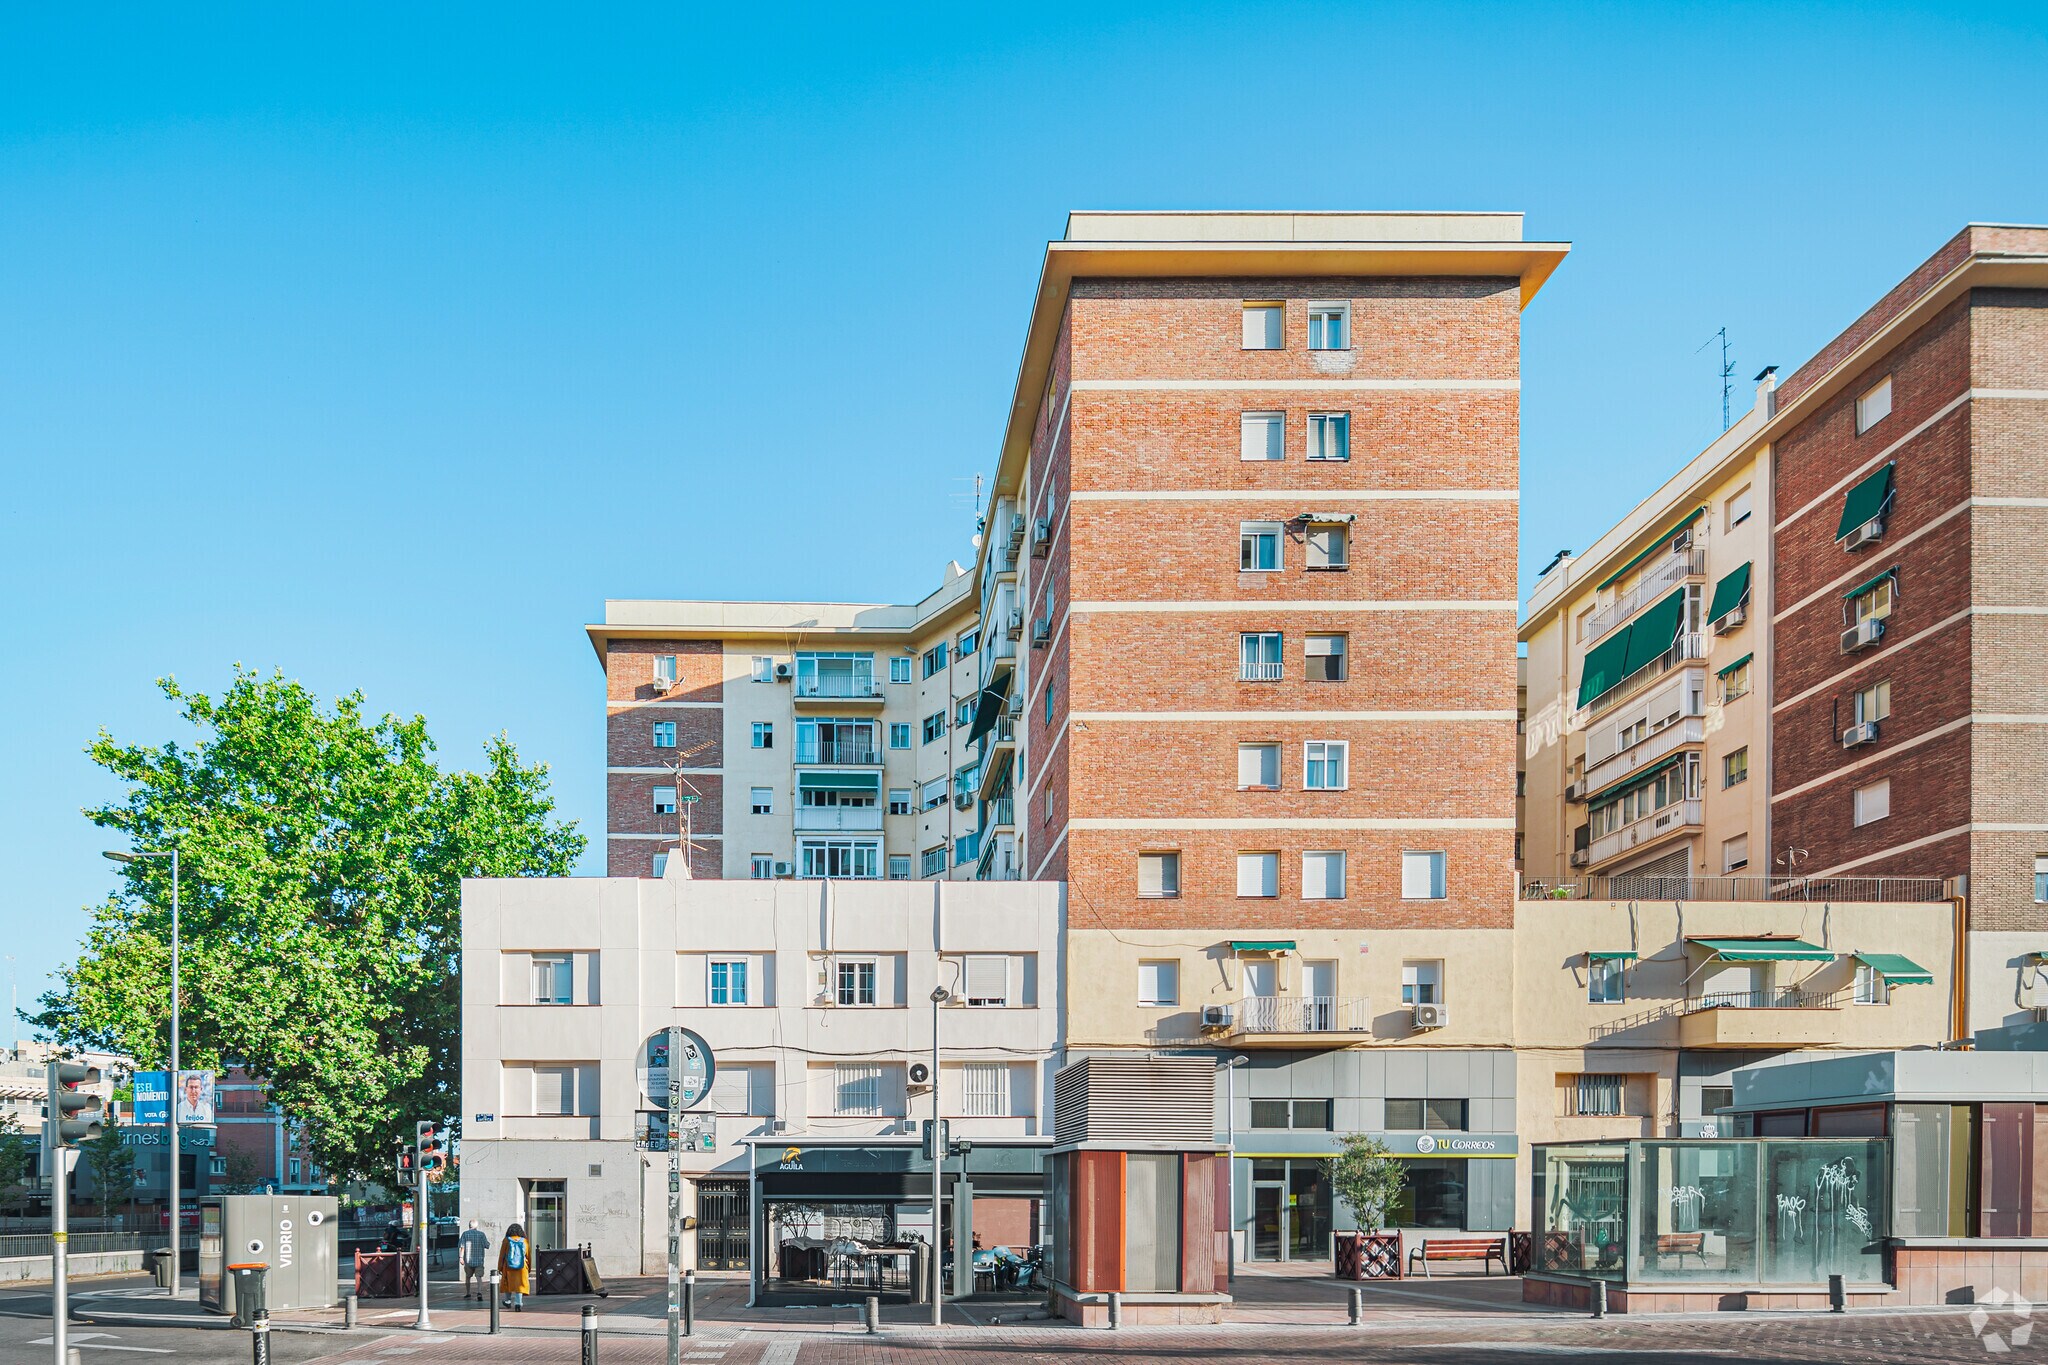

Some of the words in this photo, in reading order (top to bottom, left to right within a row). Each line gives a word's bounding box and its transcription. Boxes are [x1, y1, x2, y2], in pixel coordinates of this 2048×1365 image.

[136, 1083, 144, 1092] ES
[145, 1083, 153, 1092] EL
[136, 1092, 169, 1102] MOMENTO
[1437, 1139, 1449, 1149] TU
[280, 1219, 292, 1268] VIDRIO
